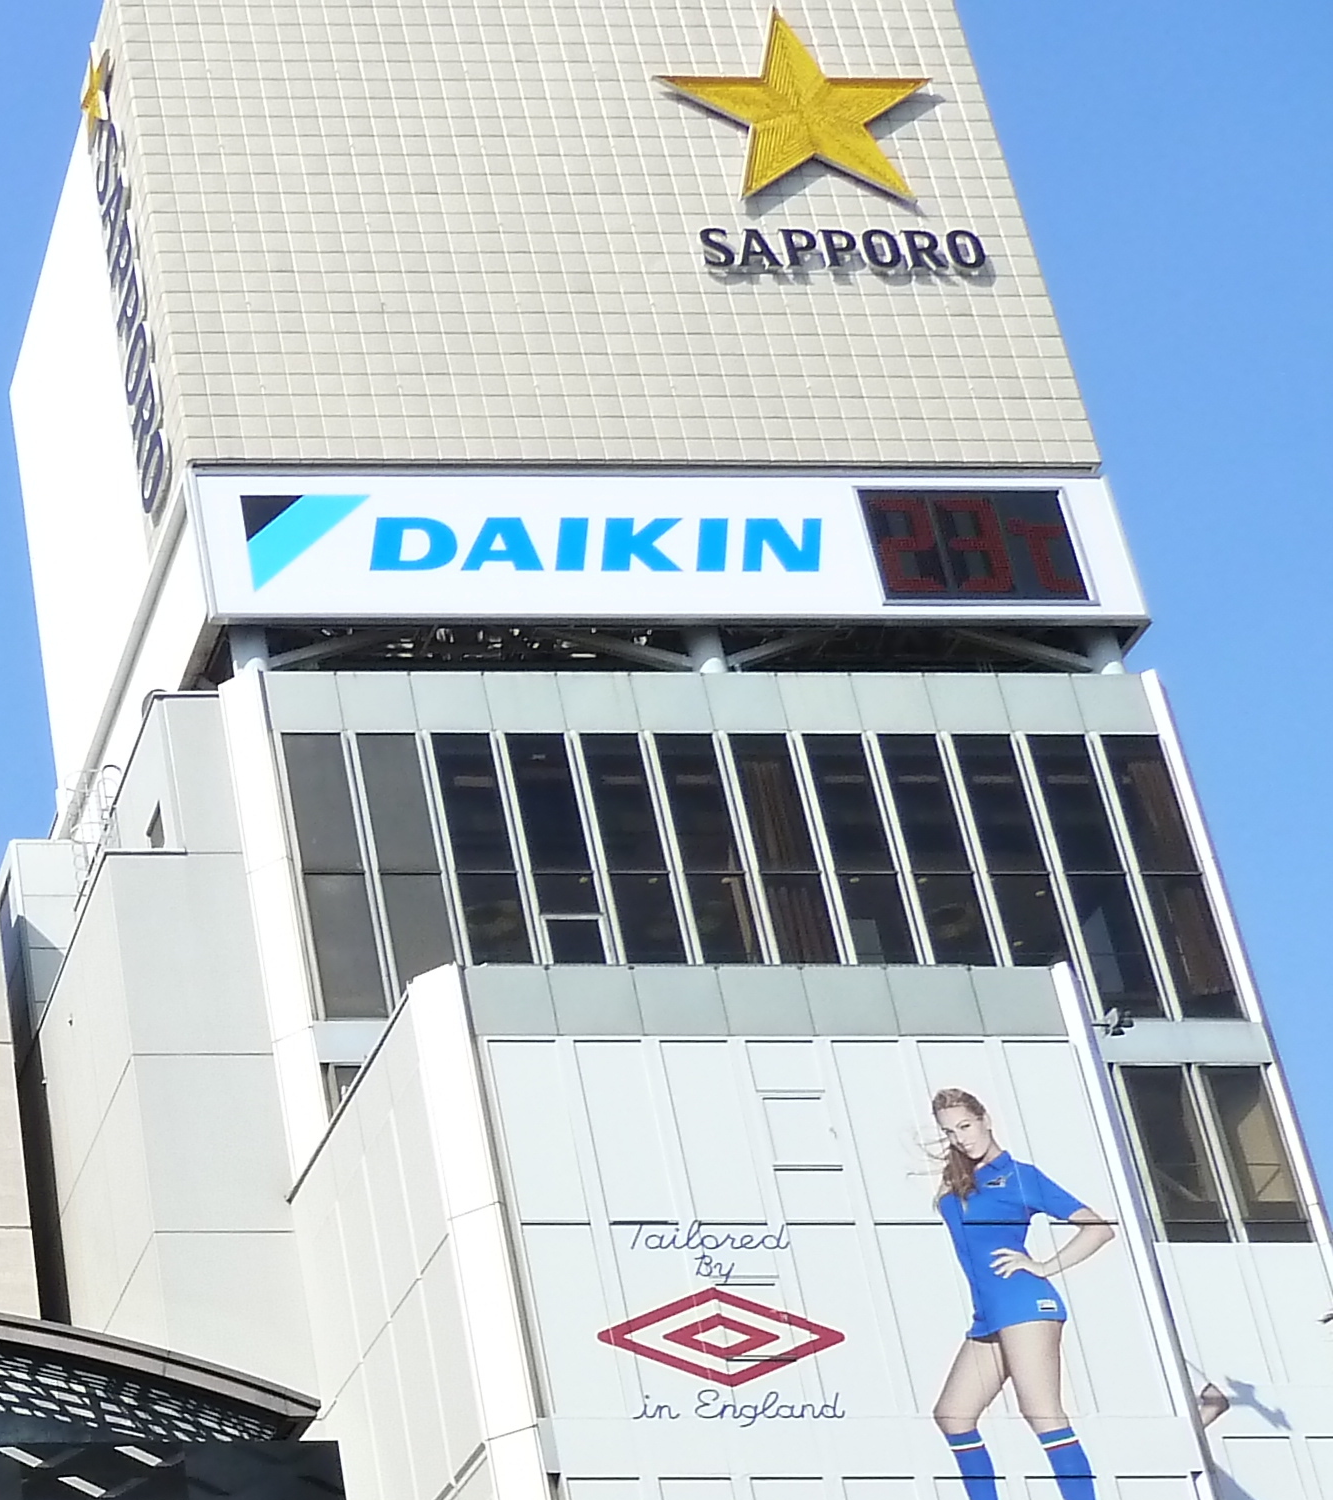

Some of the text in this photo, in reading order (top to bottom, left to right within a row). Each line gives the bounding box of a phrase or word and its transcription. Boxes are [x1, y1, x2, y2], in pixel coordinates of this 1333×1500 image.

[699, 227, 986, 272] SAPPORO
[93, 122, 171, 514] SAPPORO
[369, 516, 821, 572] DAIKIN
[630, 1218, 791, 1252] Tailored
[694, 1255, 735, 1284] By
[633, 1389, 846, 1428] in England
